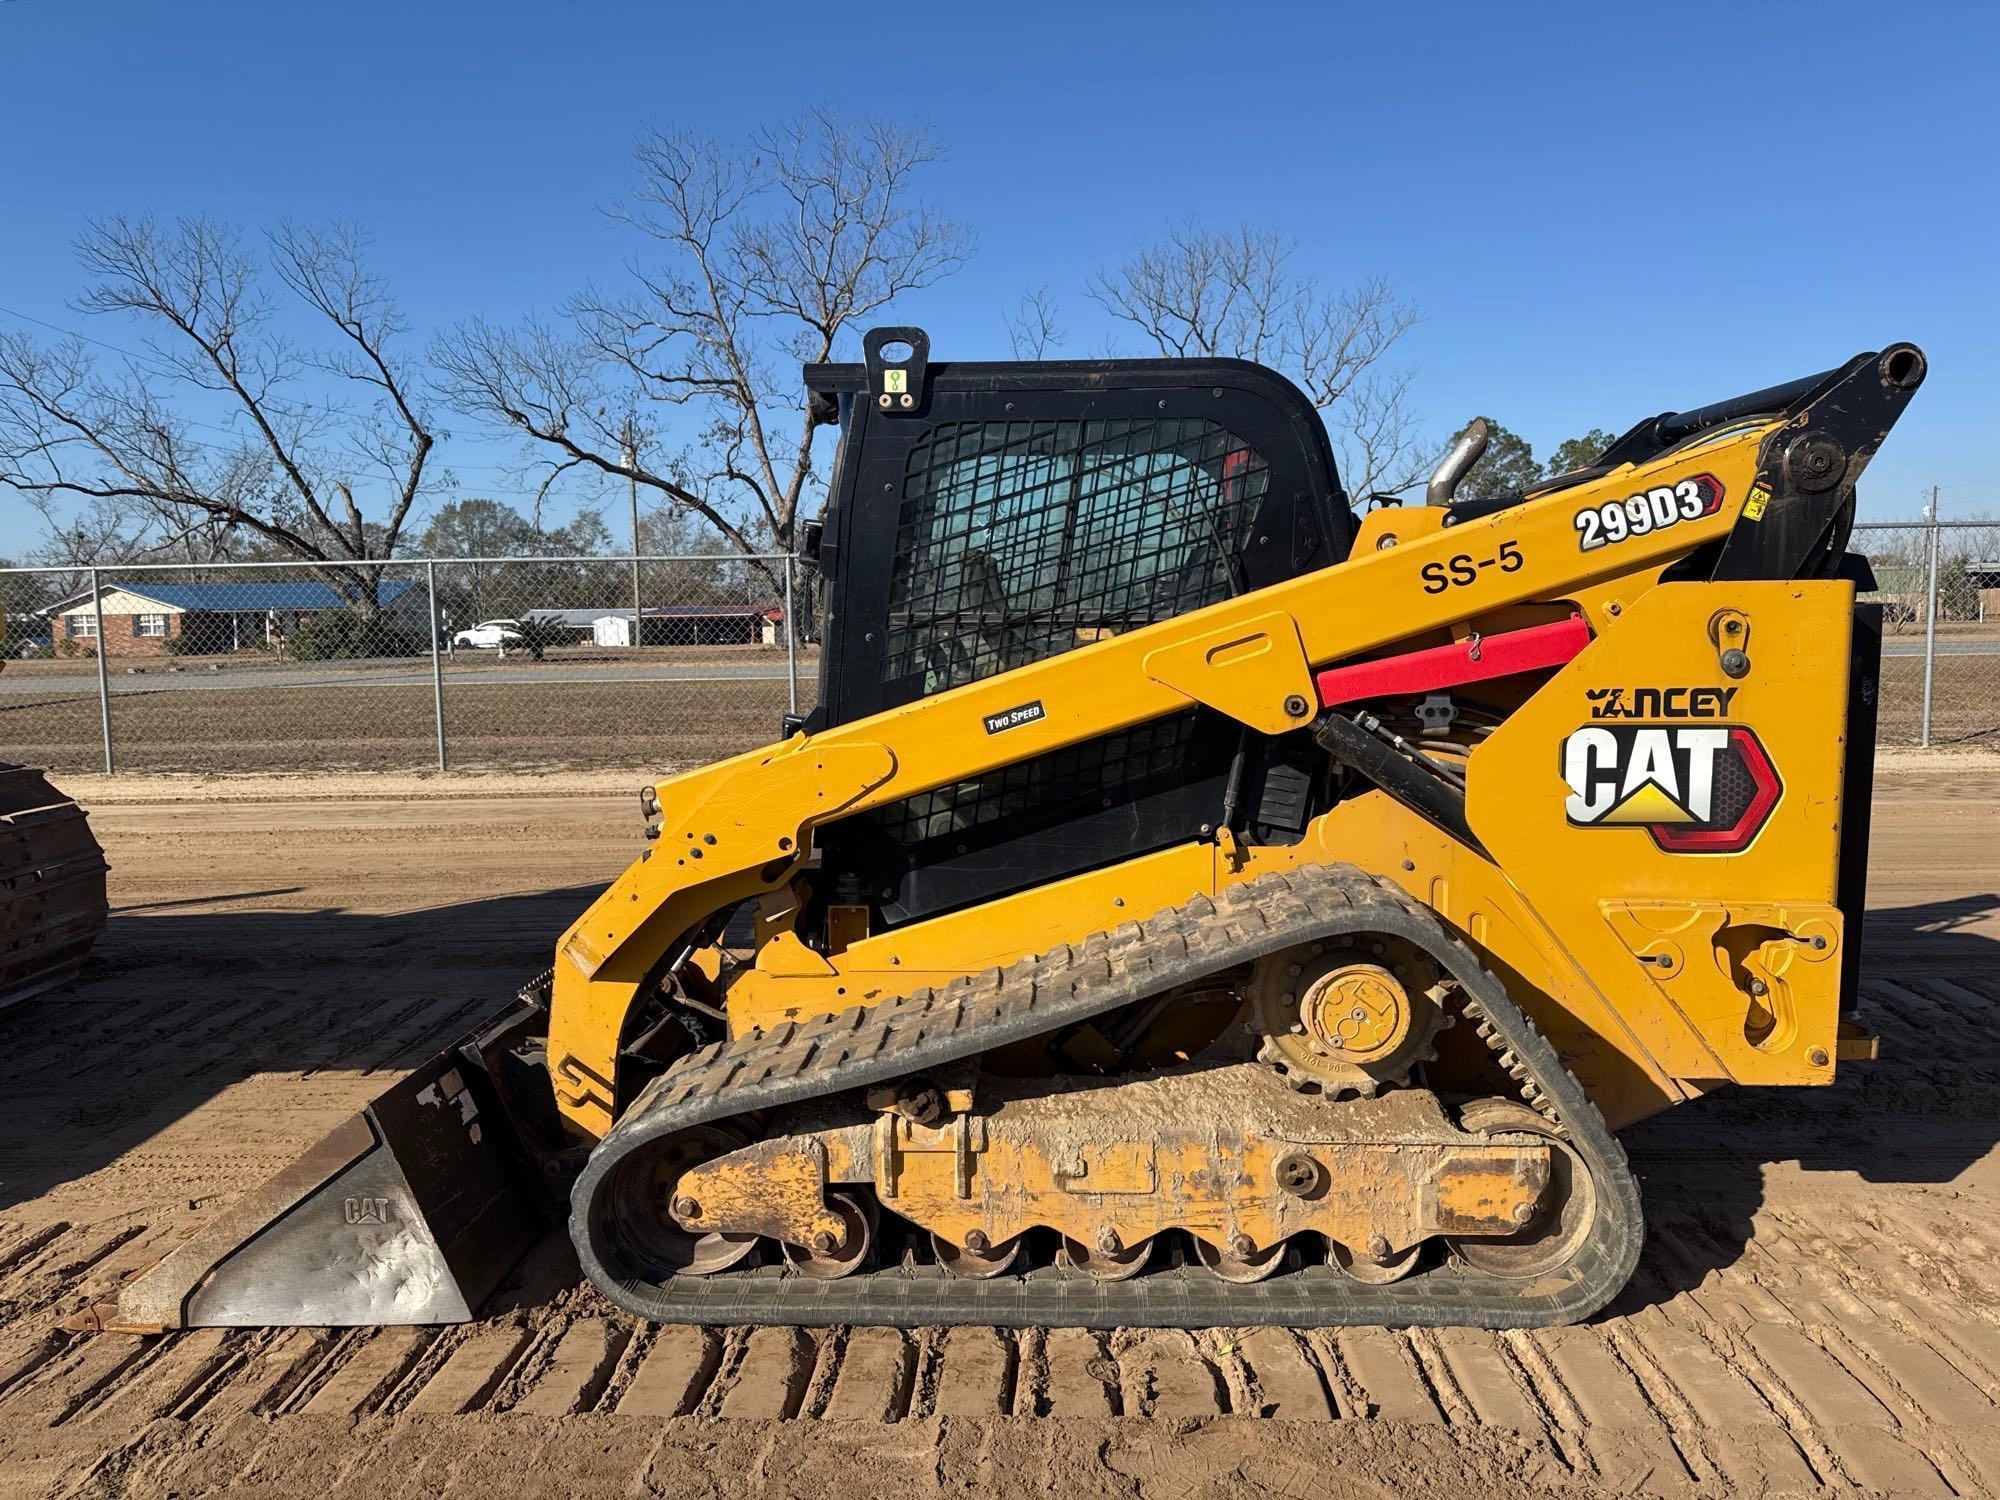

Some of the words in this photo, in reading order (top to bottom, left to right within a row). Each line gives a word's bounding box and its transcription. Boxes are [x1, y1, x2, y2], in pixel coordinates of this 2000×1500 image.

[1575, 480, 1704, 551] 299D3
[1421, 539, 1524, 595] SS-5
[1585, 687, 1739, 718] YANCEY
[1565, 727, 1729, 822] CAT
[344, 1198, 389, 1224] CAT
